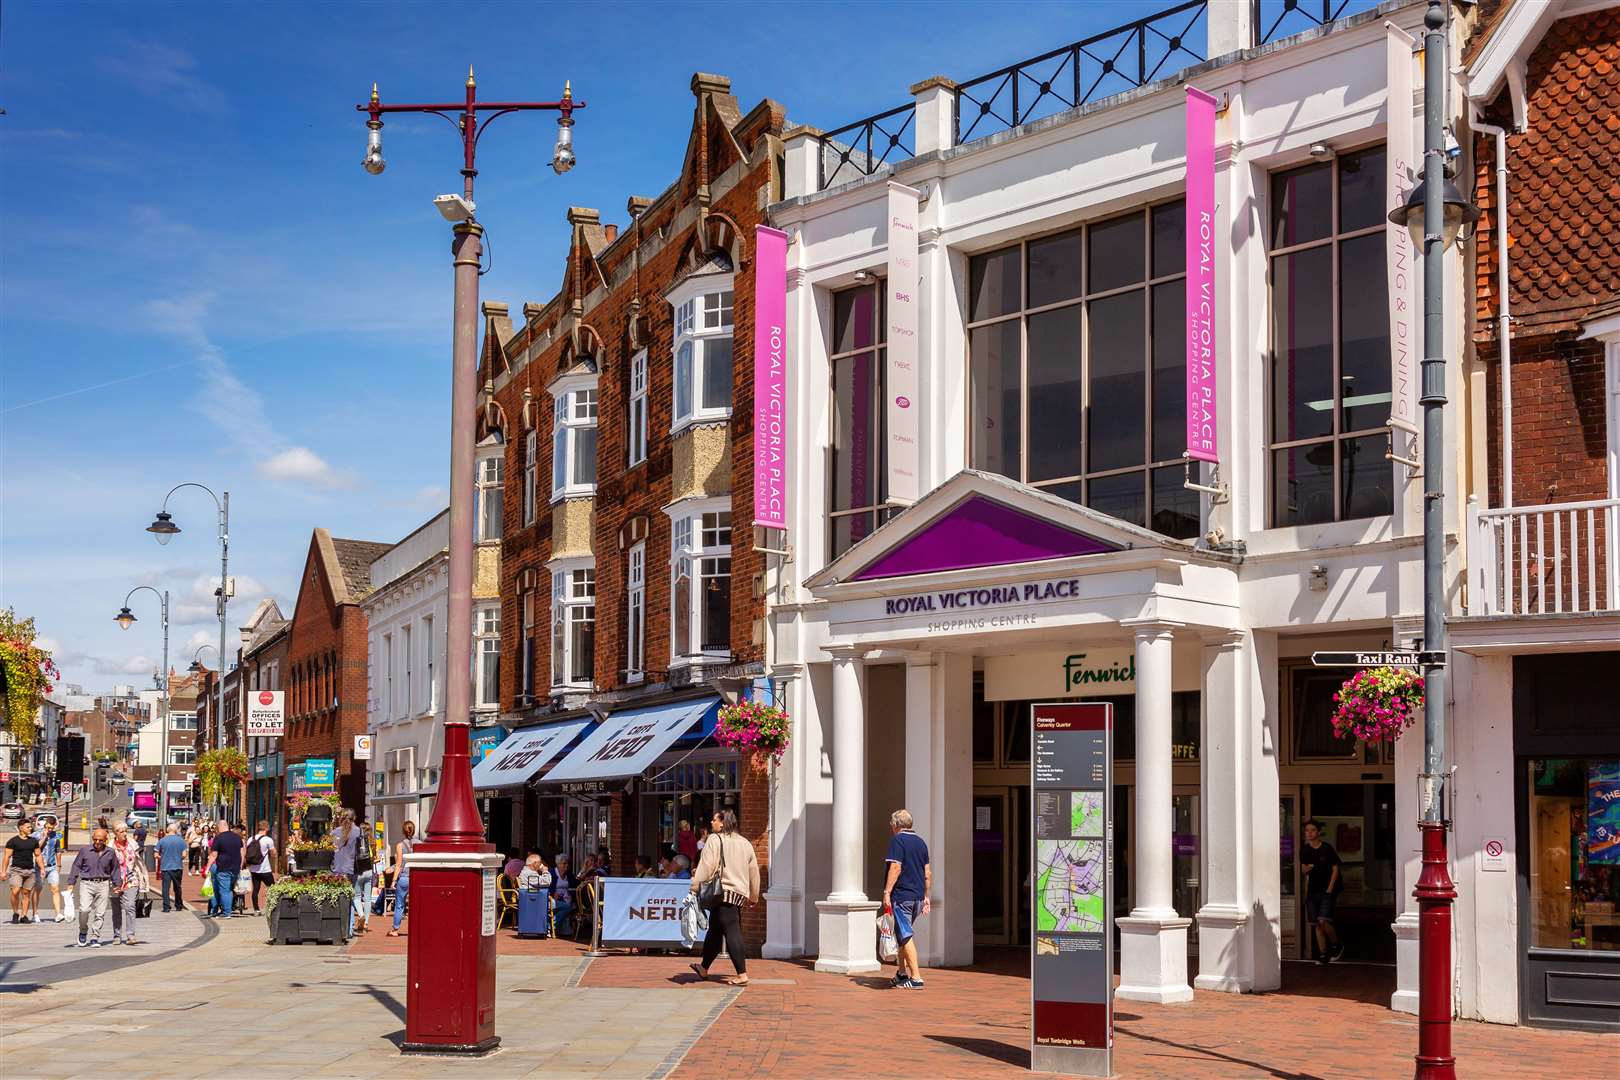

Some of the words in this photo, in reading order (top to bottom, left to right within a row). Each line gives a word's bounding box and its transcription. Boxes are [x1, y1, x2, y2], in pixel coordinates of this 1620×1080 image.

[1200, 211, 1211, 276] ROYAL
[1395, 159, 1407, 290] SHOPING
[895, 292, 911, 303] BHS
[1396, 297, 1406, 311] &
[769, 325, 782, 378] ROYAL
[1191, 311, 1199, 385] SHOPPING
[1200, 282, 1211, 380] VICTORIA
[1397, 321, 1408, 416] DINING
[759, 406, 767, 467] SHOPPING
[769, 383, 782, 463] VICTORIA
[1191, 391, 1200, 448] CENTRE
[1201, 386, 1213, 450] PLACE
[759, 472, 767, 518] CENTRE
[769, 467, 781, 520] PLACE
[885, 595, 936, 615] ROYAL
[938, 585, 1020, 609] VICTORIA
[1023, 579, 1080, 601] PLACE
[927, 617, 985, 633] SHOPPING
[991, 613, 1037, 627] CENTRE
[1356, 653, 1382, 664] Taxi
[1385, 653, 1419, 664] Rank
[489, 749, 543, 772] NERO
[586, 735, 656, 762] NERO
[1171, 741, 1196, 759] AFFÈ
[1601, 789, 1620, 802] THE
[629, 906, 684, 921] NER
